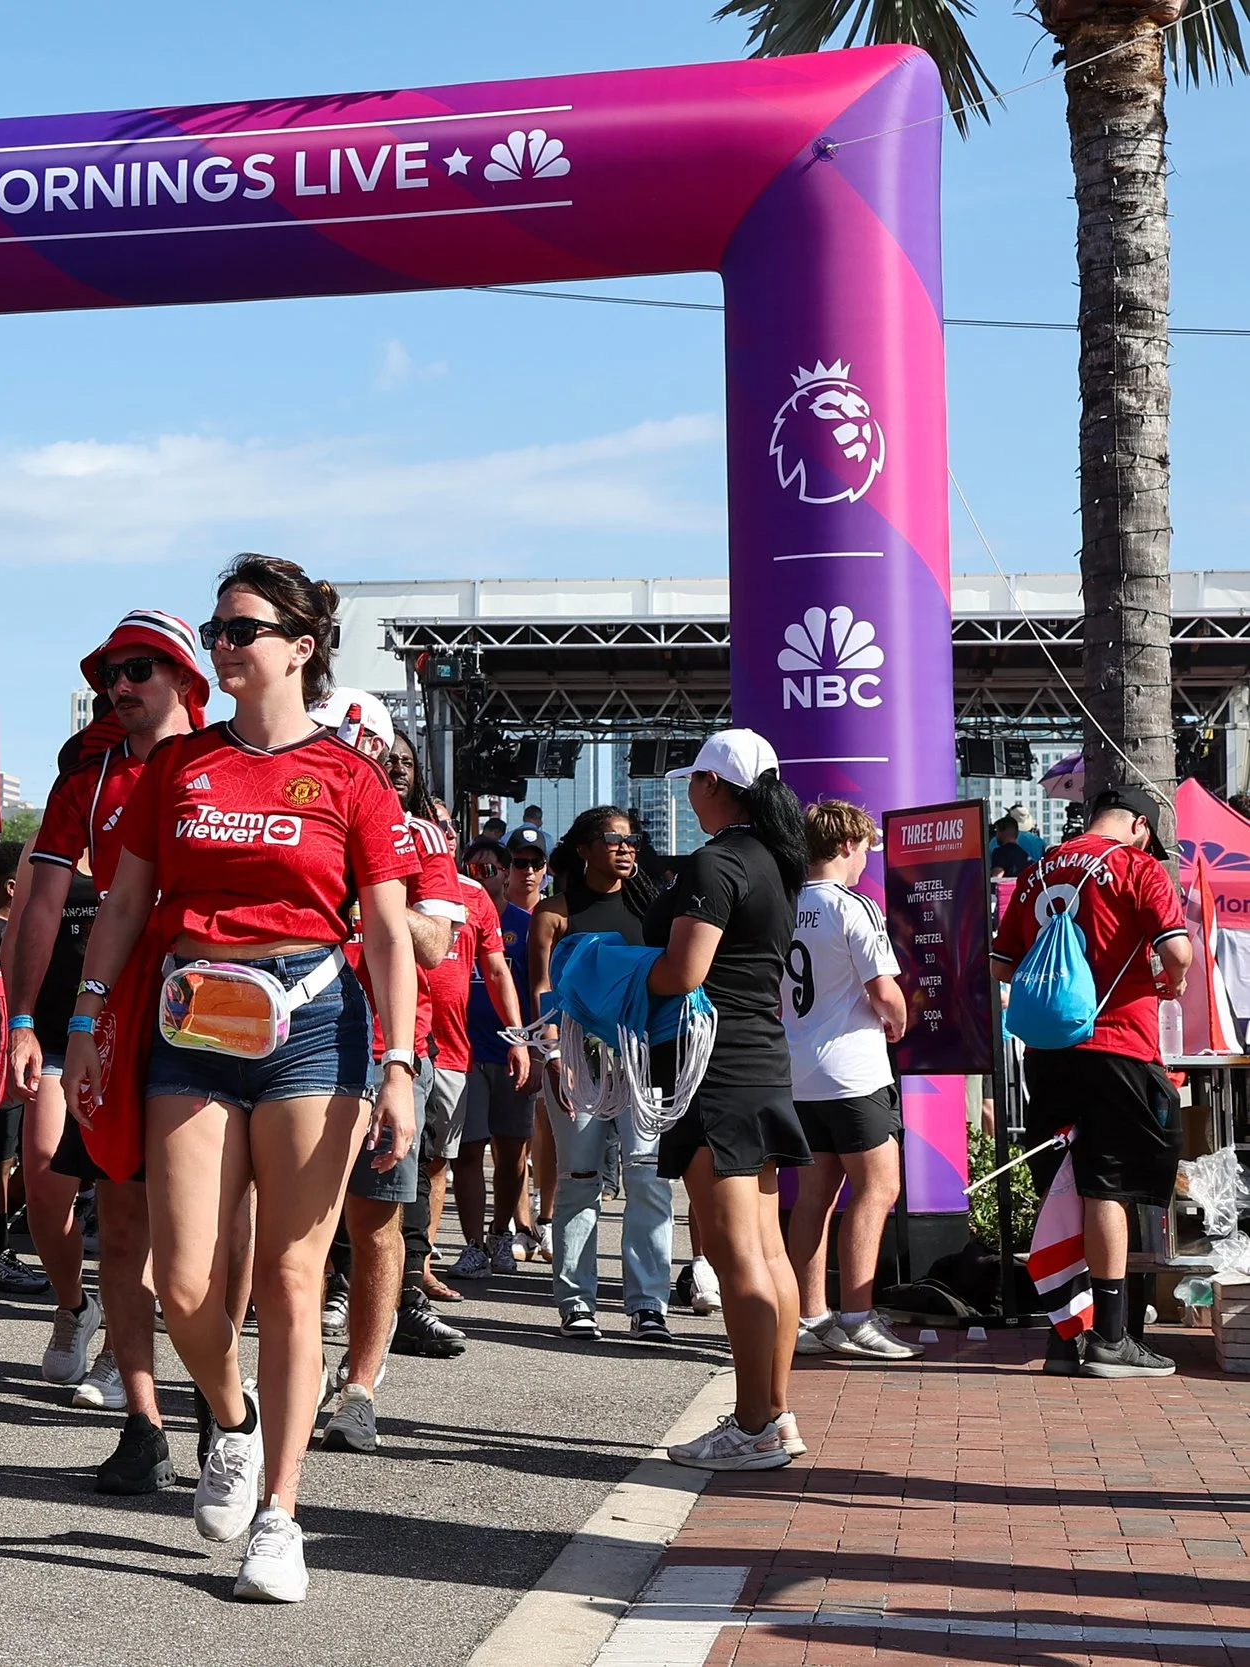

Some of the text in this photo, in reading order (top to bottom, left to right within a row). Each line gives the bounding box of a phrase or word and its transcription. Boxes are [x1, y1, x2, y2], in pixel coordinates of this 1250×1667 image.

[294, 140, 430, 196] LIVE
[782, 673, 883, 710] NBC
[197, 804, 265, 829] Team
[175, 819, 262, 843] Viewer
[901, 818, 964, 846] THREE OAKS
[914, 879, 944, 892] PRETZEL
[907, 889, 953, 904] WITH CHEESE
[923, 911, 934, 921] $12
[71, 924, 80, 935] IS
[915, 933, 944, 945] PRETZEL
[925, 953, 936, 964] $10
[783, 939, 815, 1019] 9
[919, 975, 943, 987] WATER
[928, 987, 936, 998] $5
[923, 1010, 943, 1021] SODA
[930, 1021, 939, 1032] $4
